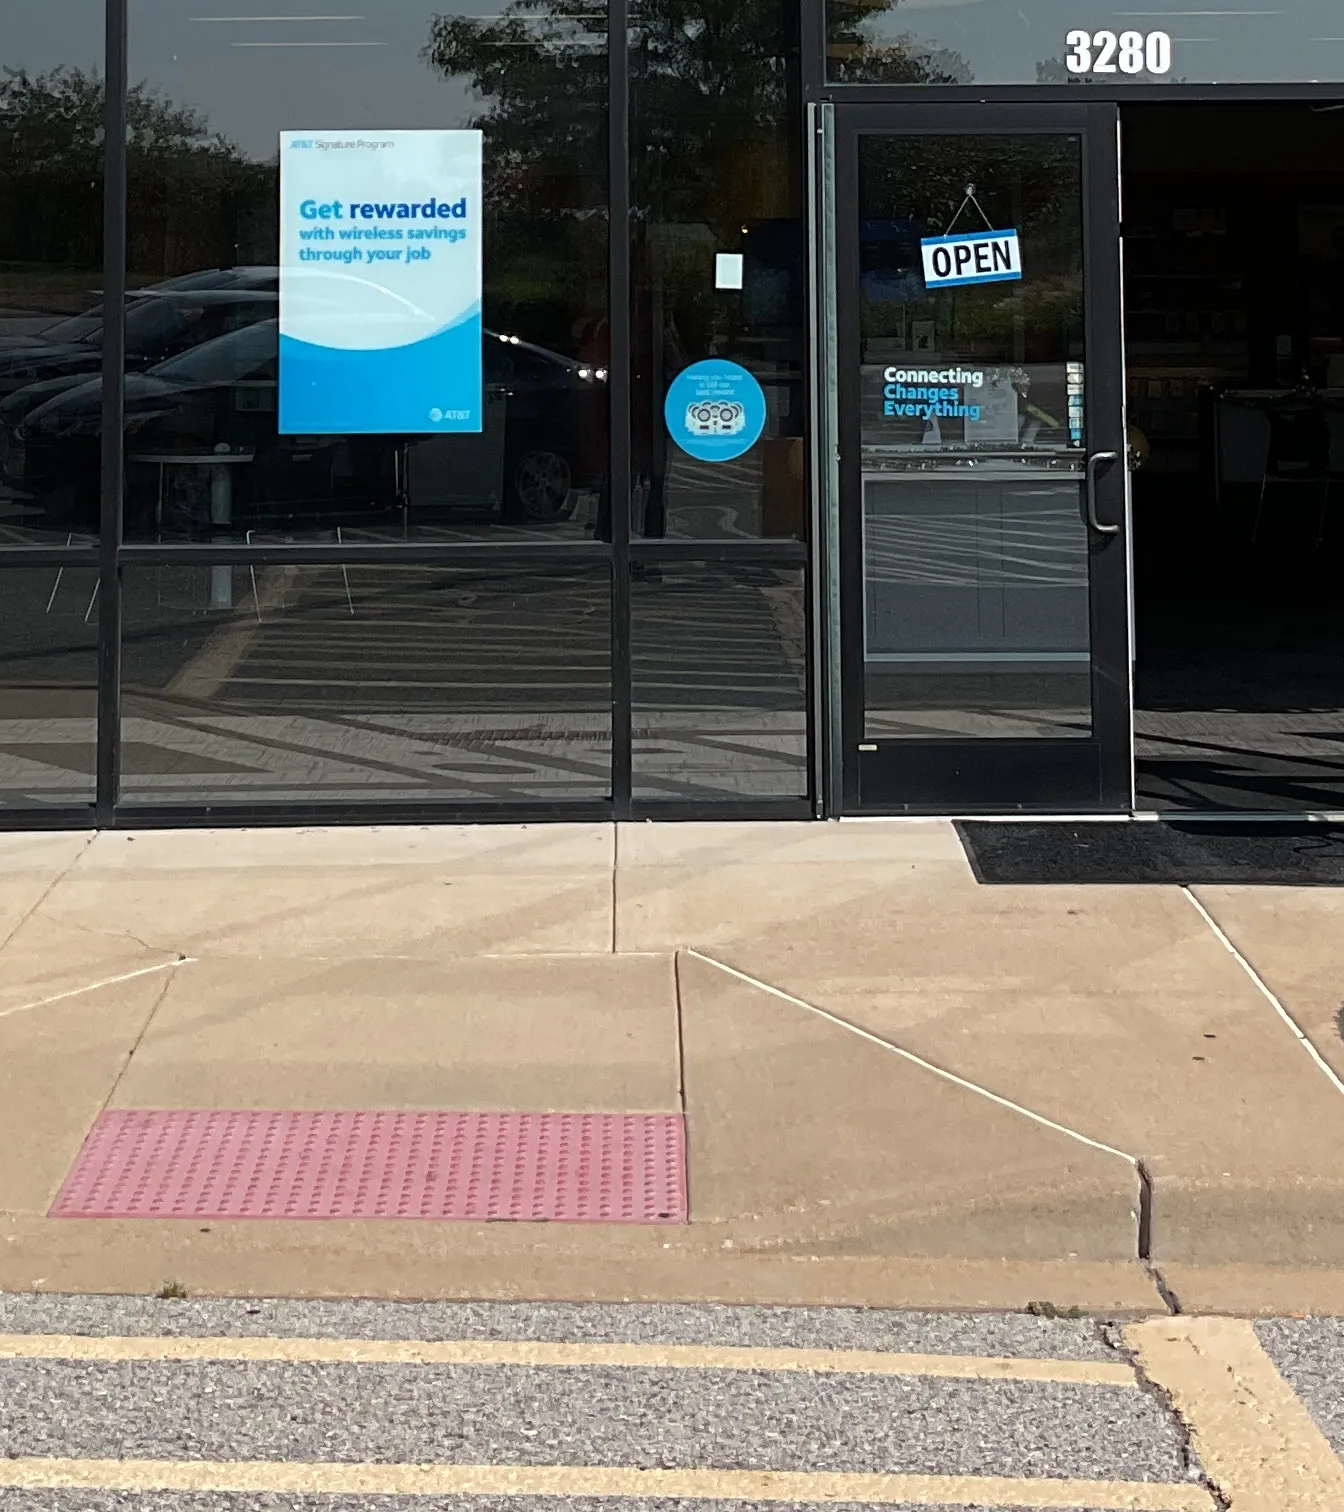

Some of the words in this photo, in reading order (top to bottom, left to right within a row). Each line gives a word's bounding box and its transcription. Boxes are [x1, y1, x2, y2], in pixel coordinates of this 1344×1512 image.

[1066, 30, 1171, 74] 3280
[315, 139, 356, 151] Signature
[357, 139, 395, 151] Program
[300, 199, 343, 220] Get
[350, 197, 467, 219] rewarded
[299, 226, 335, 240] with
[339, 226, 403, 240] wireless
[407, 226, 467, 243] savings
[299, 247, 362, 264] through
[366, 250, 403, 264] your
[405, 247, 431, 264] job
[932, 239, 1011, 278] OPEN
[884, 367, 984, 388] Connecting
[884, 384, 959, 401] Changes
[444, 409, 471, 420] AT&T
[884, 400, 981, 421] Everything
